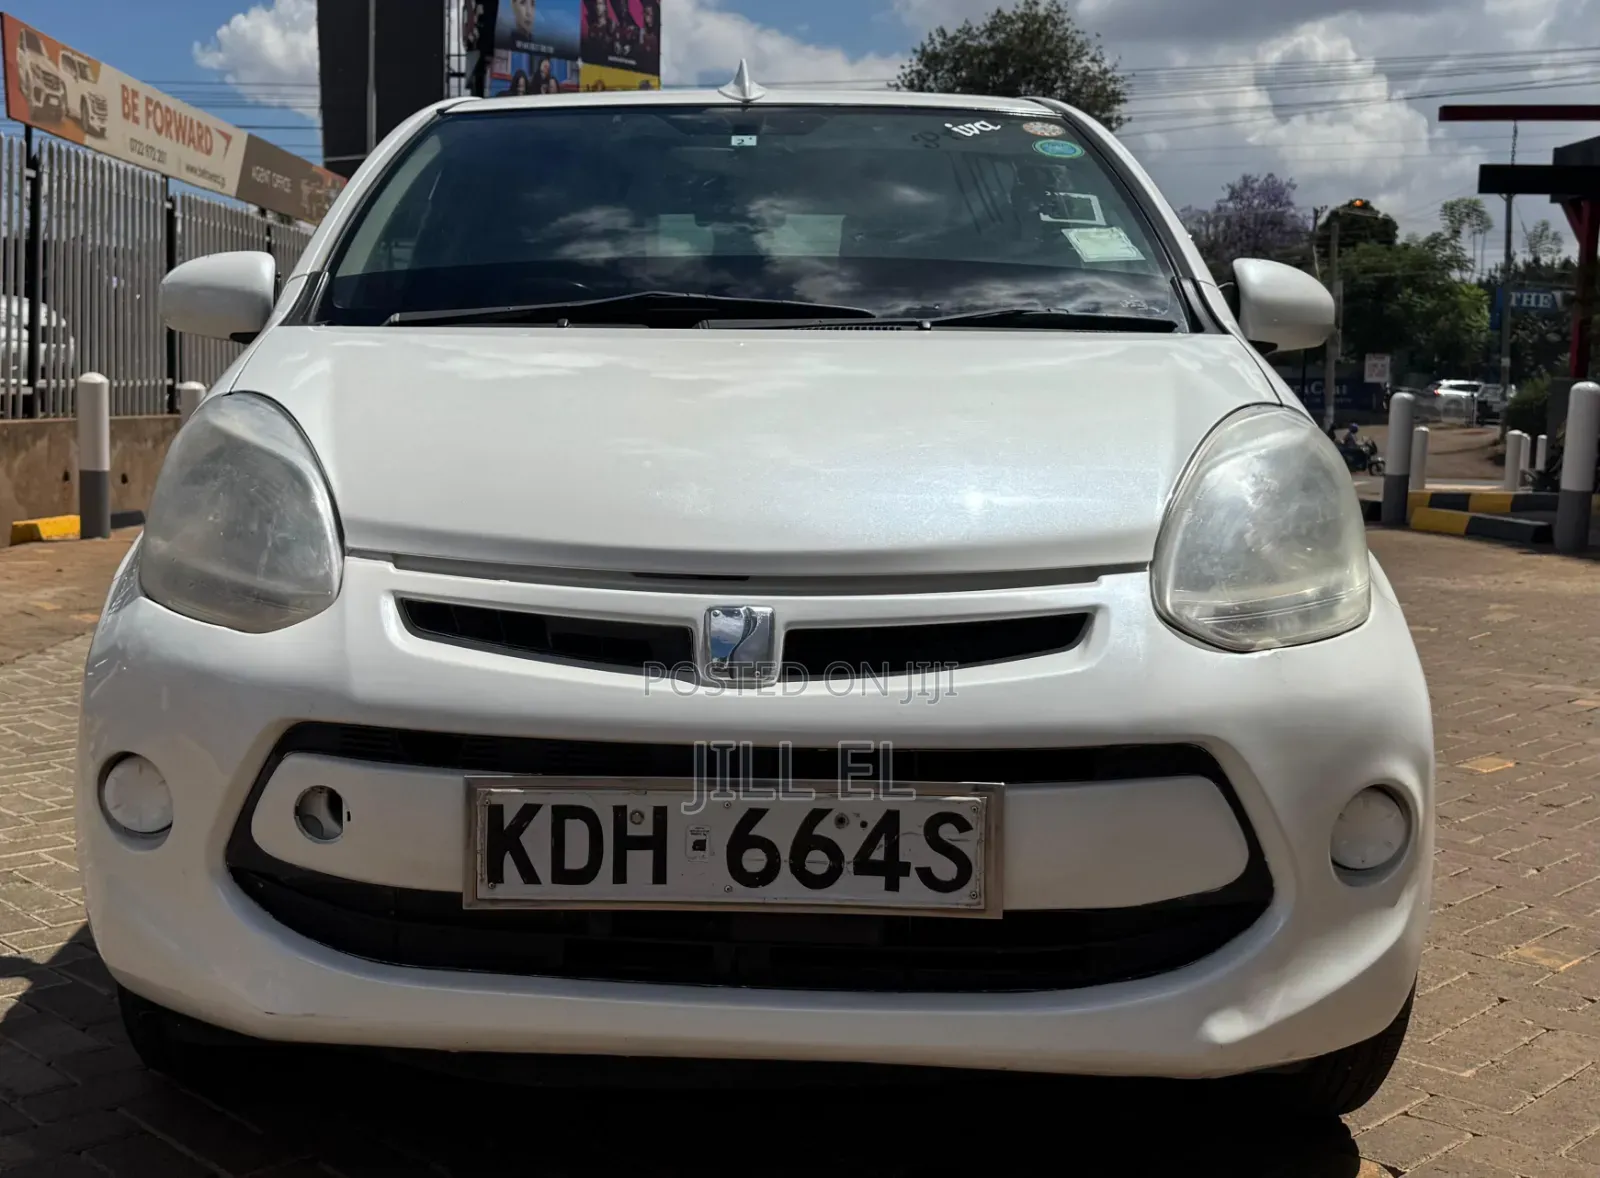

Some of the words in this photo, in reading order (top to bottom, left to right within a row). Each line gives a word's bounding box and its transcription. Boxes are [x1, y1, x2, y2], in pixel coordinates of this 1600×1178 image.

[121, 83, 140, 125] BE
[145, 95, 214, 157] FORWARD
[1508, 290, 1552, 309] THE
[486, 803, 668, 886] KDH
[726, 807, 975, 894] 664S
